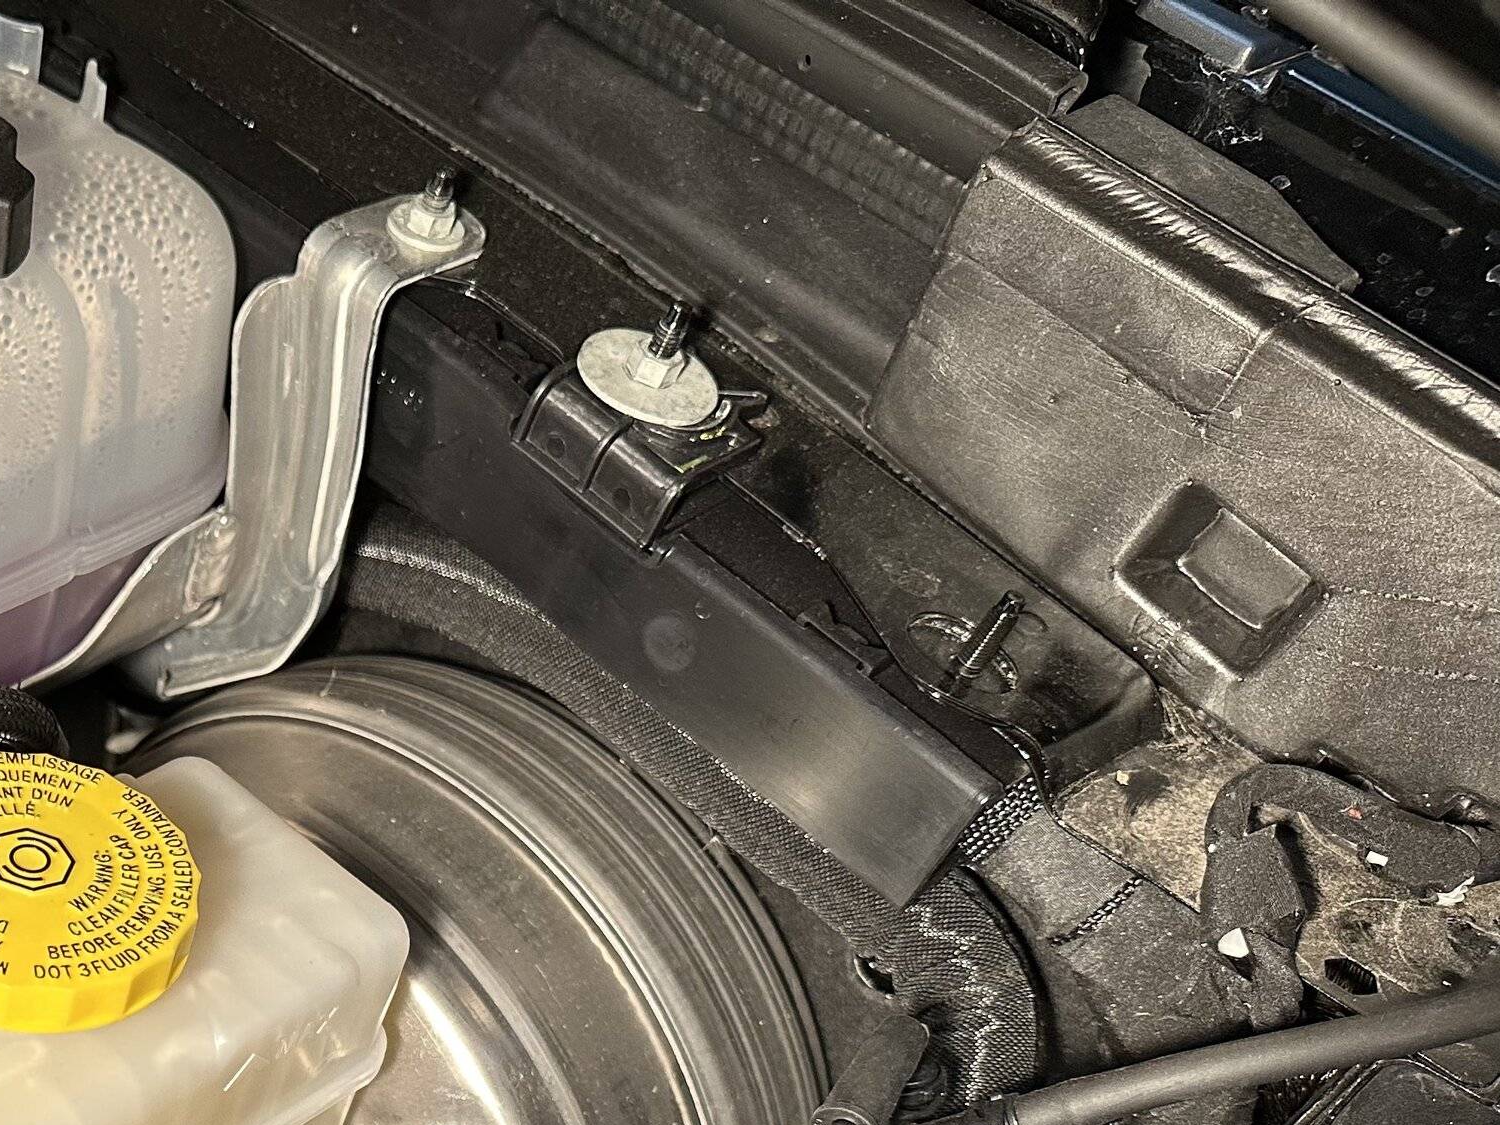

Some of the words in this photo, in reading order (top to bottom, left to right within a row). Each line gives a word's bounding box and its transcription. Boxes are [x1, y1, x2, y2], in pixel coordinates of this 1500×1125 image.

[31, 787, 75, 808] D'UN
[111, 809, 152, 840] ONLY
[122, 786, 188, 857] CONTAINER.
[109, 834, 137, 860] CAP
[140, 843, 164, 870] USE
[68, 850, 115, 912] WARNING:
[112, 863, 141, 908] FILLER
[171, 860, 193, 909] SEALED
[67, 903, 124, 936] CLEAN
[116, 873, 167, 939] REMOVING.
[166, 911, 186, 923] A
[47, 932, 121, 960] BEFORE
[136, 919, 179, 955] FROM
[33, 964, 72, 980] DOT
[77, 962, 92, 978] 3
[91, 948, 141, 975] FLUID
